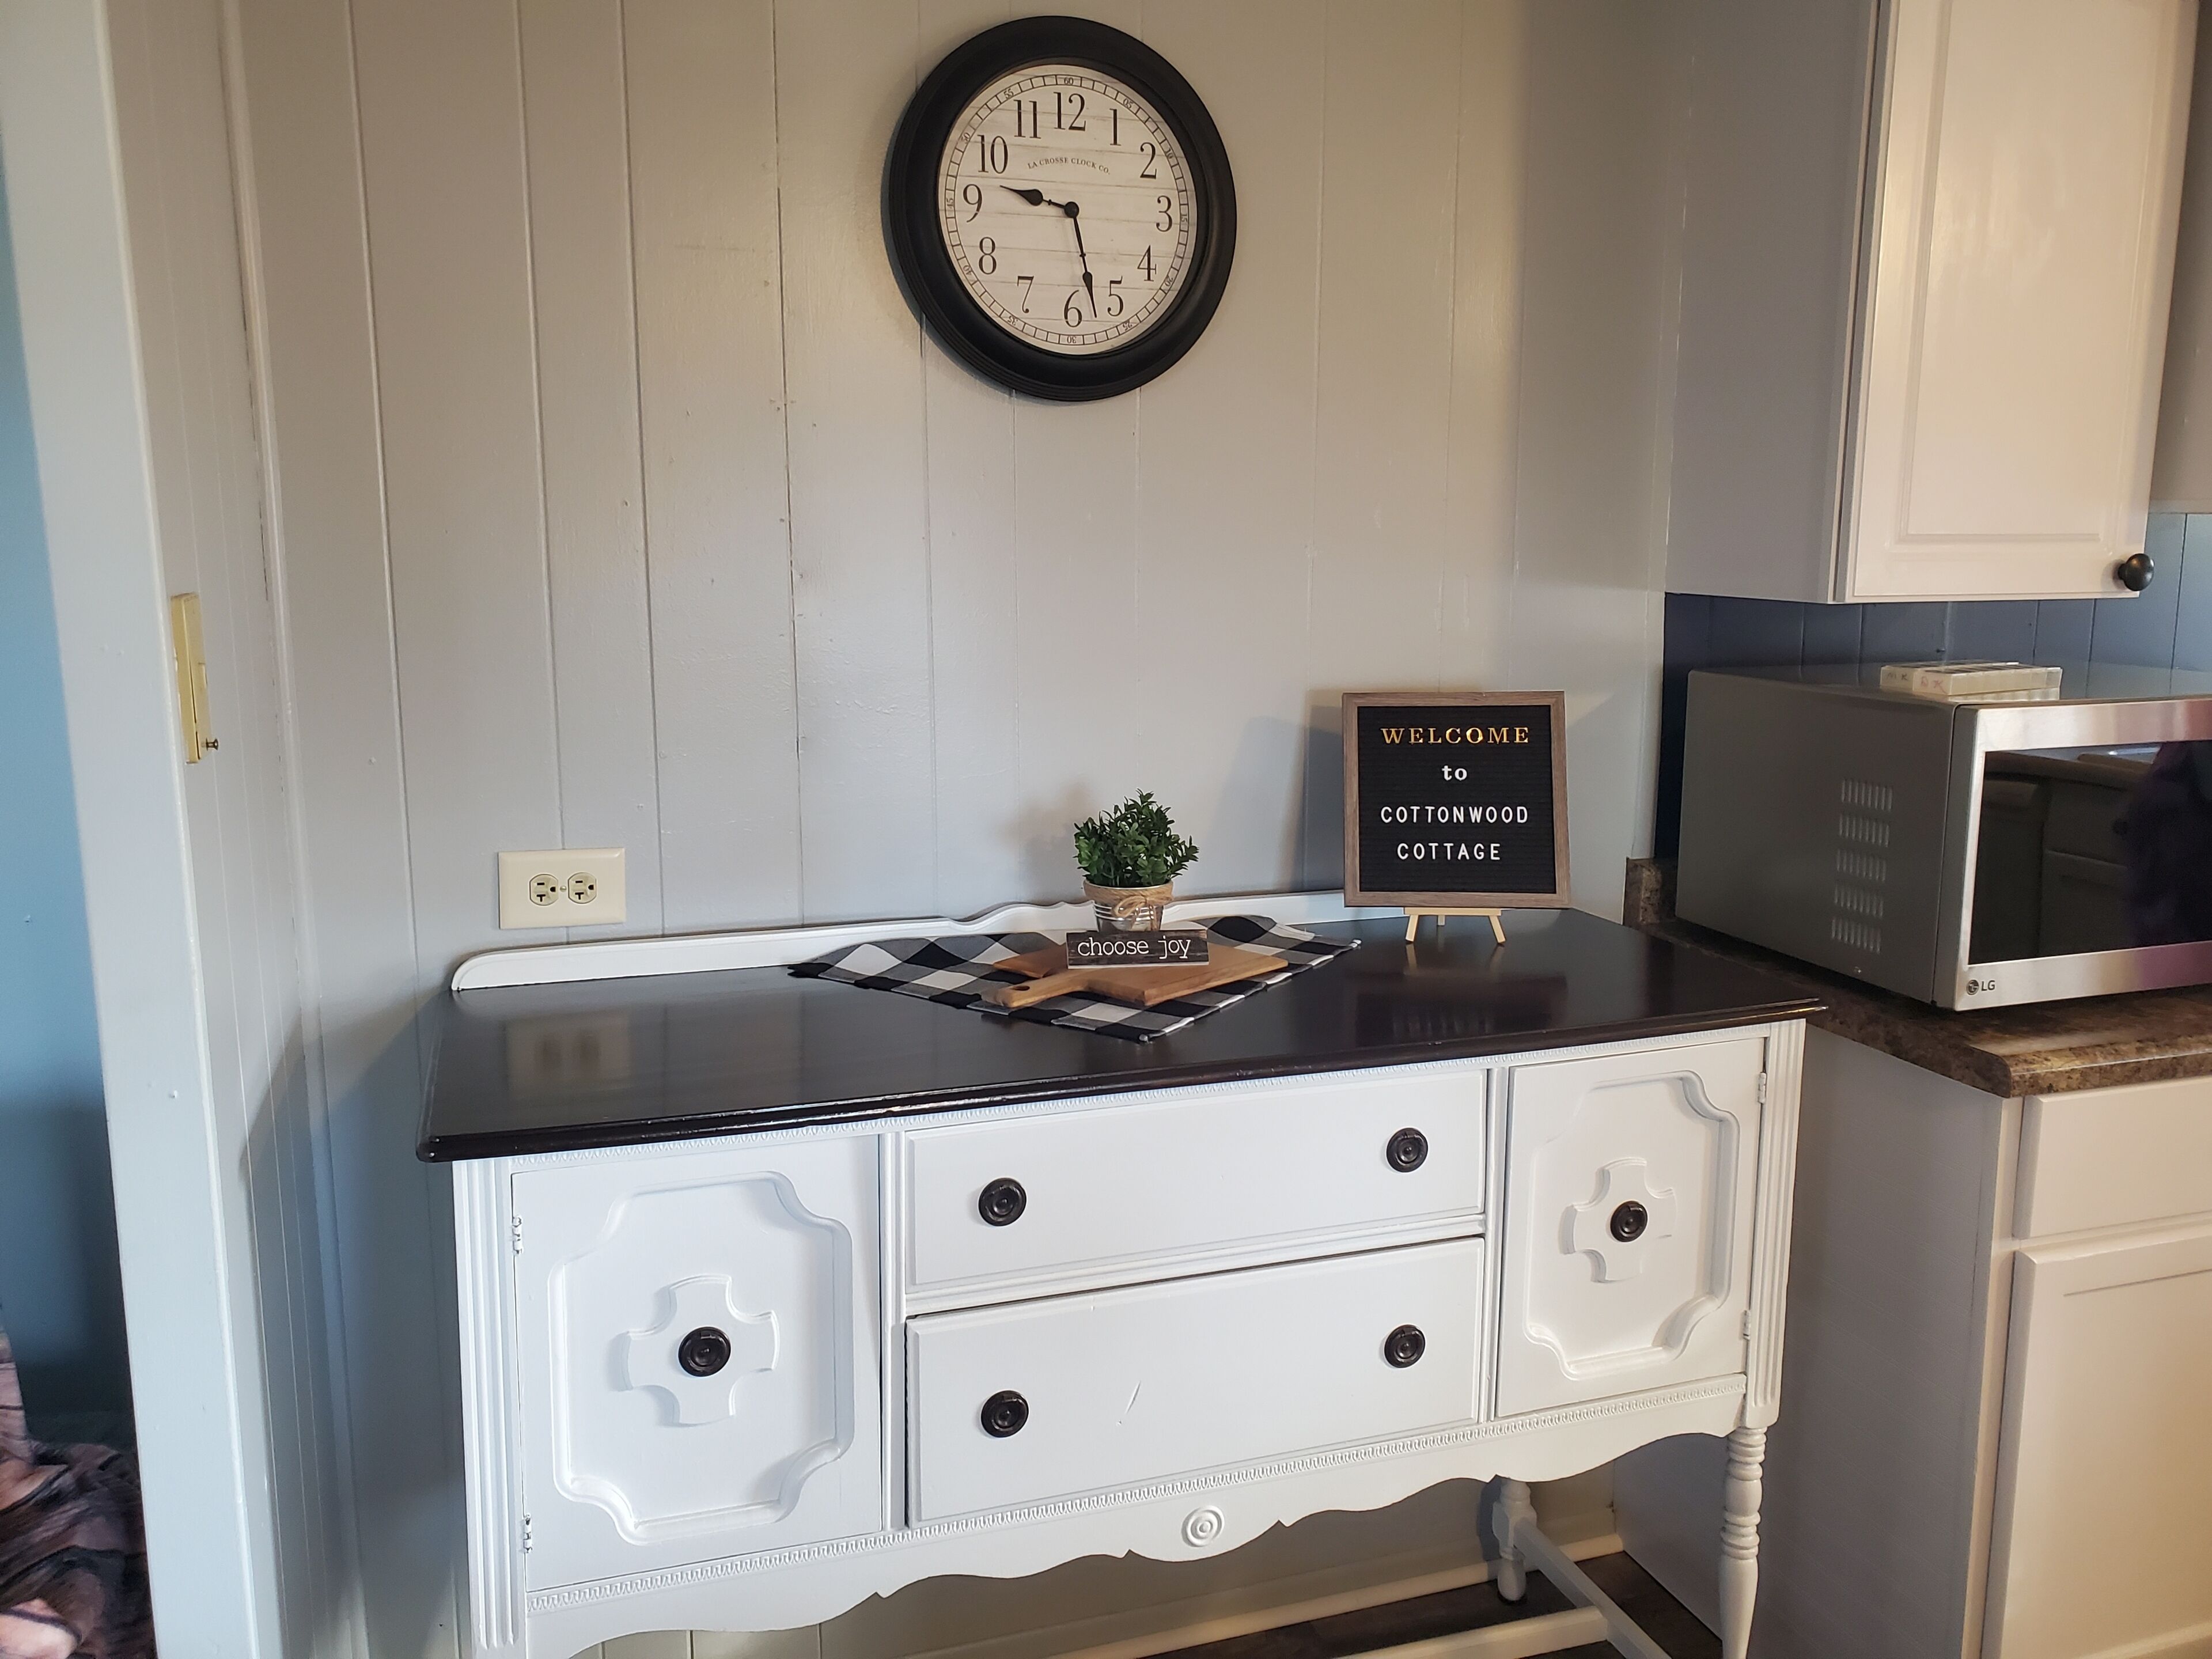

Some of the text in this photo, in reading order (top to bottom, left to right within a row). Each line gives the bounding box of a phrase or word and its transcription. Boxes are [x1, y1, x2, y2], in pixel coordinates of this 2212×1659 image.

[1063, 77, 1074, 85] 60
[1003, 88, 1014, 99] 55
[1123, 98, 1134, 109] 05
[1013, 99, 1041, 139] 11
[1053, 92, 1086, 132] 12
[1109, 108, 1122, 146] 1
[977, 134, 1008, 174] 10
[1027, 157, 1111, 175] LA CROSSE CLOCK CO.
[1139, 142, 1157, 180] 2
[963, 183, 983, 223] 9
[1156, 195, 1173, 232] 3
[1180, 213, 1188, 223] 15
[979, 236, 997, 275] 8
[1137, 244, 1157, 282] 4
[1164, 275, 1173, 287] 20
[1017, 275, 1035, 313] 7
[1107, 275, 1124, 317] 5
[1063, 290, 1082, 328] 6
[1066, 335, 1077, 344] 30
[1380, 727, 1529, 745] WELCOME
[1442, 764, 1468, 781] to
[1380, 806, 1529, 823] COTTONWOOD
[1397, 842, 1501, 861] COTTAGE
[1077, 935, 1191, 959] choose joy
[1981, 980, 1996, 991] LG
